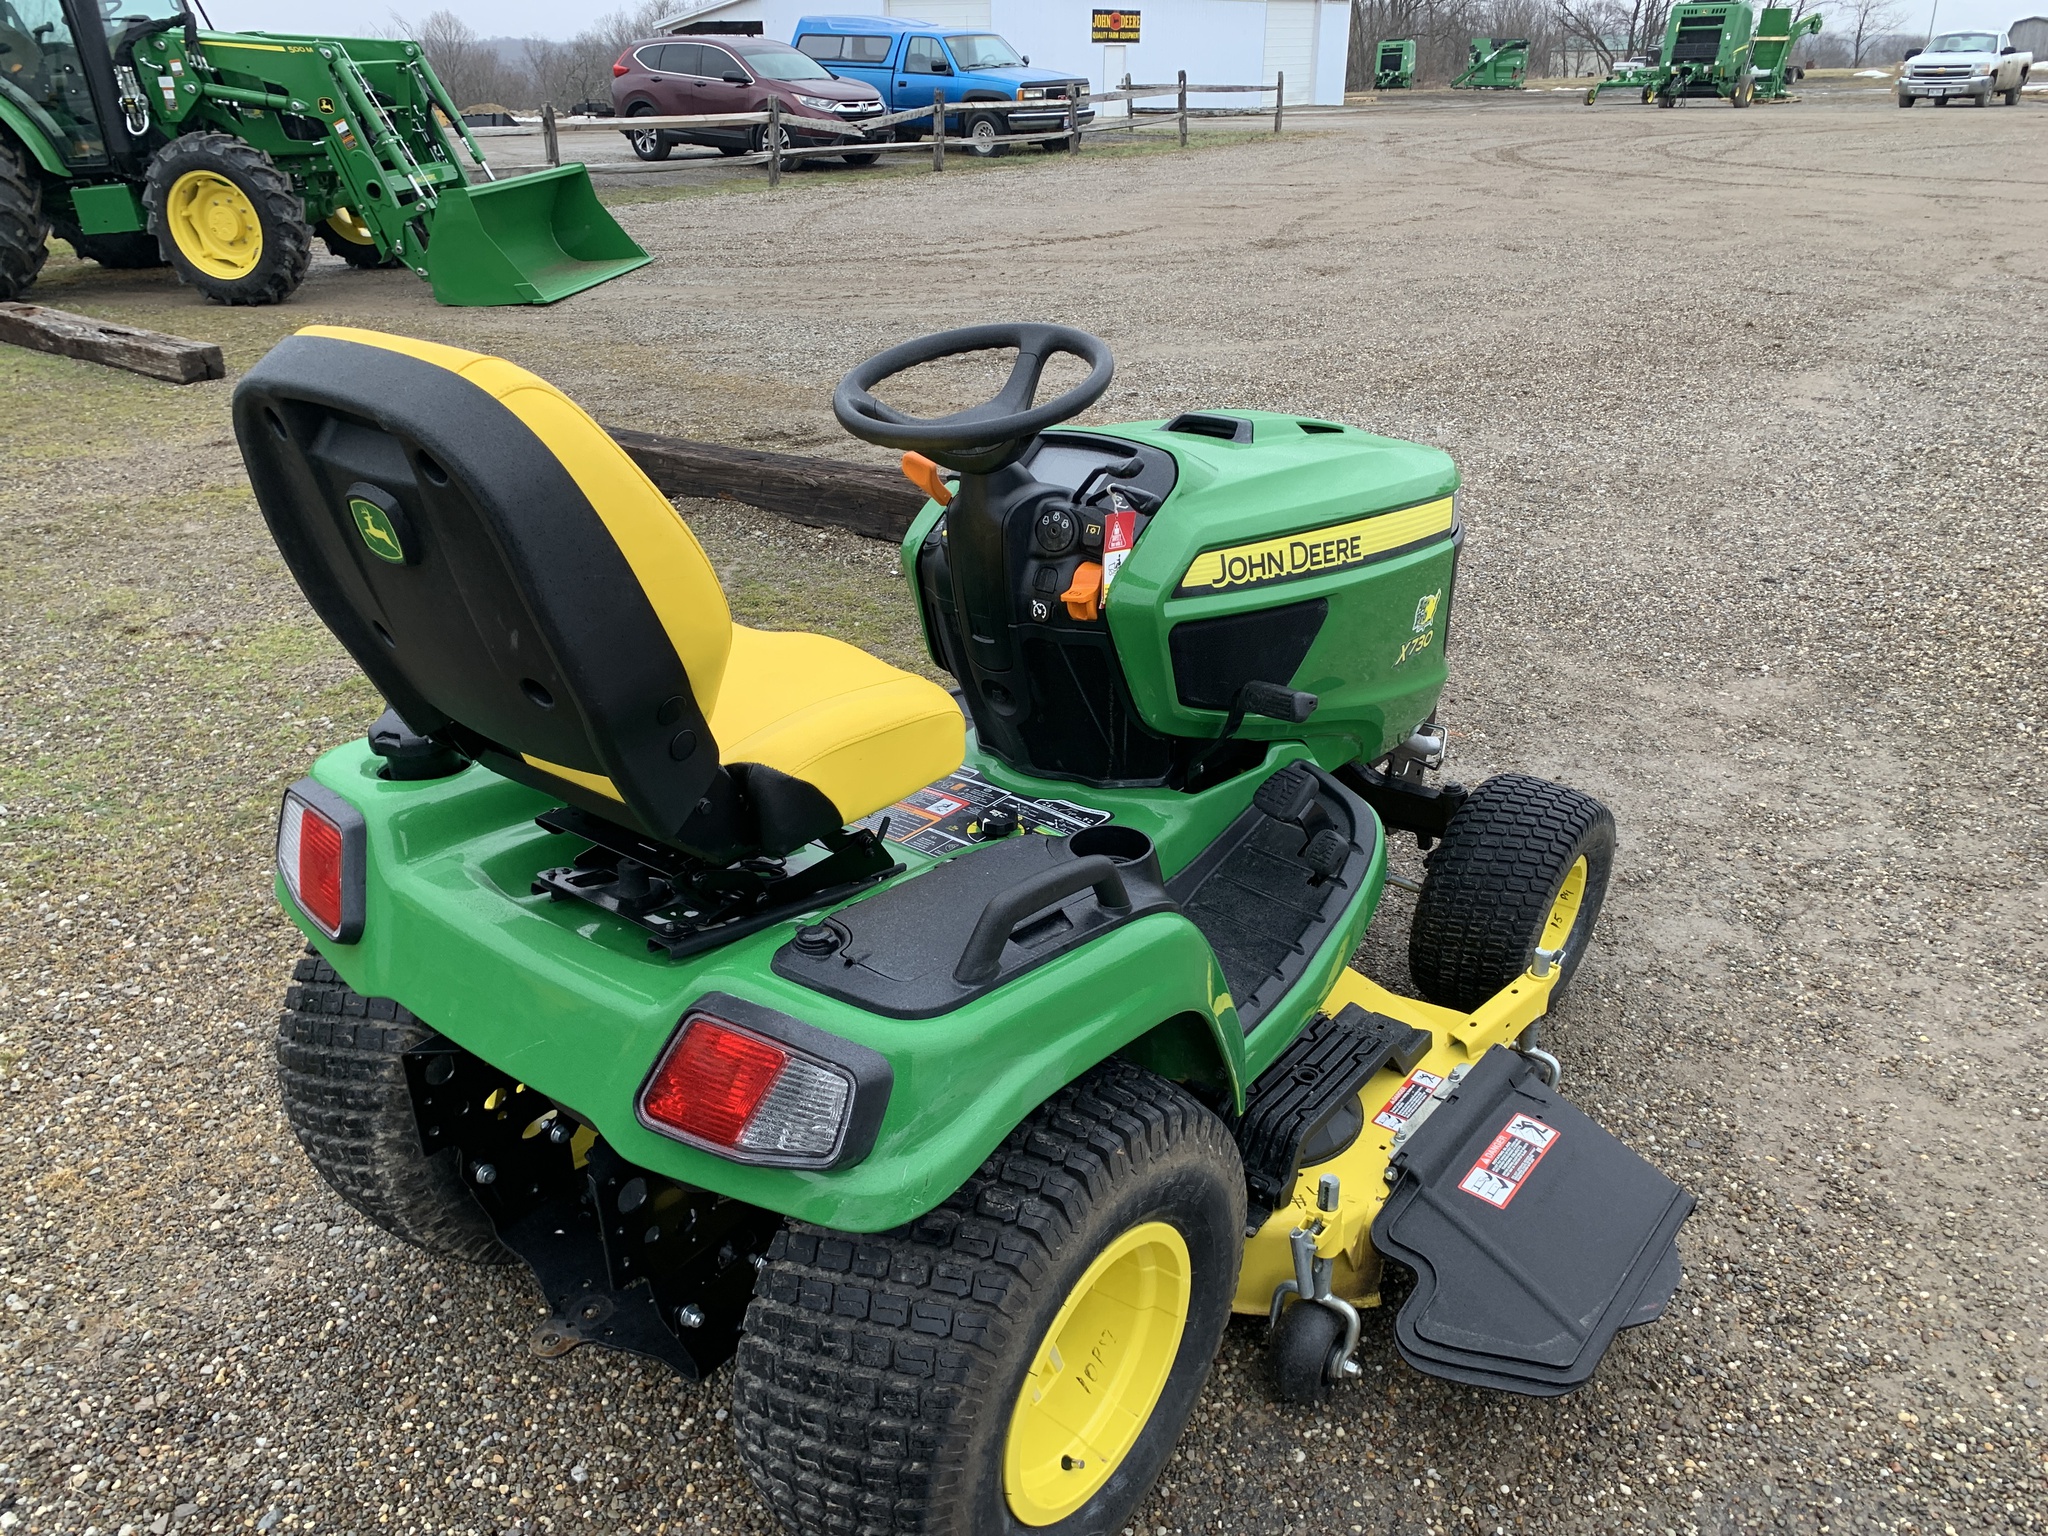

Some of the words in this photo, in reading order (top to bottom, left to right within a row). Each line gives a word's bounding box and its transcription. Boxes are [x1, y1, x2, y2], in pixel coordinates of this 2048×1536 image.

[1093, 14, 1111, 28] JOHN
[1120, 15, 1140, 28] DEERE
[1212, 550, 1285, 585] JOHN
[1290, 535, 1362, 571] DEERE
[1394, 629, 1434, 666] X730
[1484, 1135, 1508, 1159] DANGER
